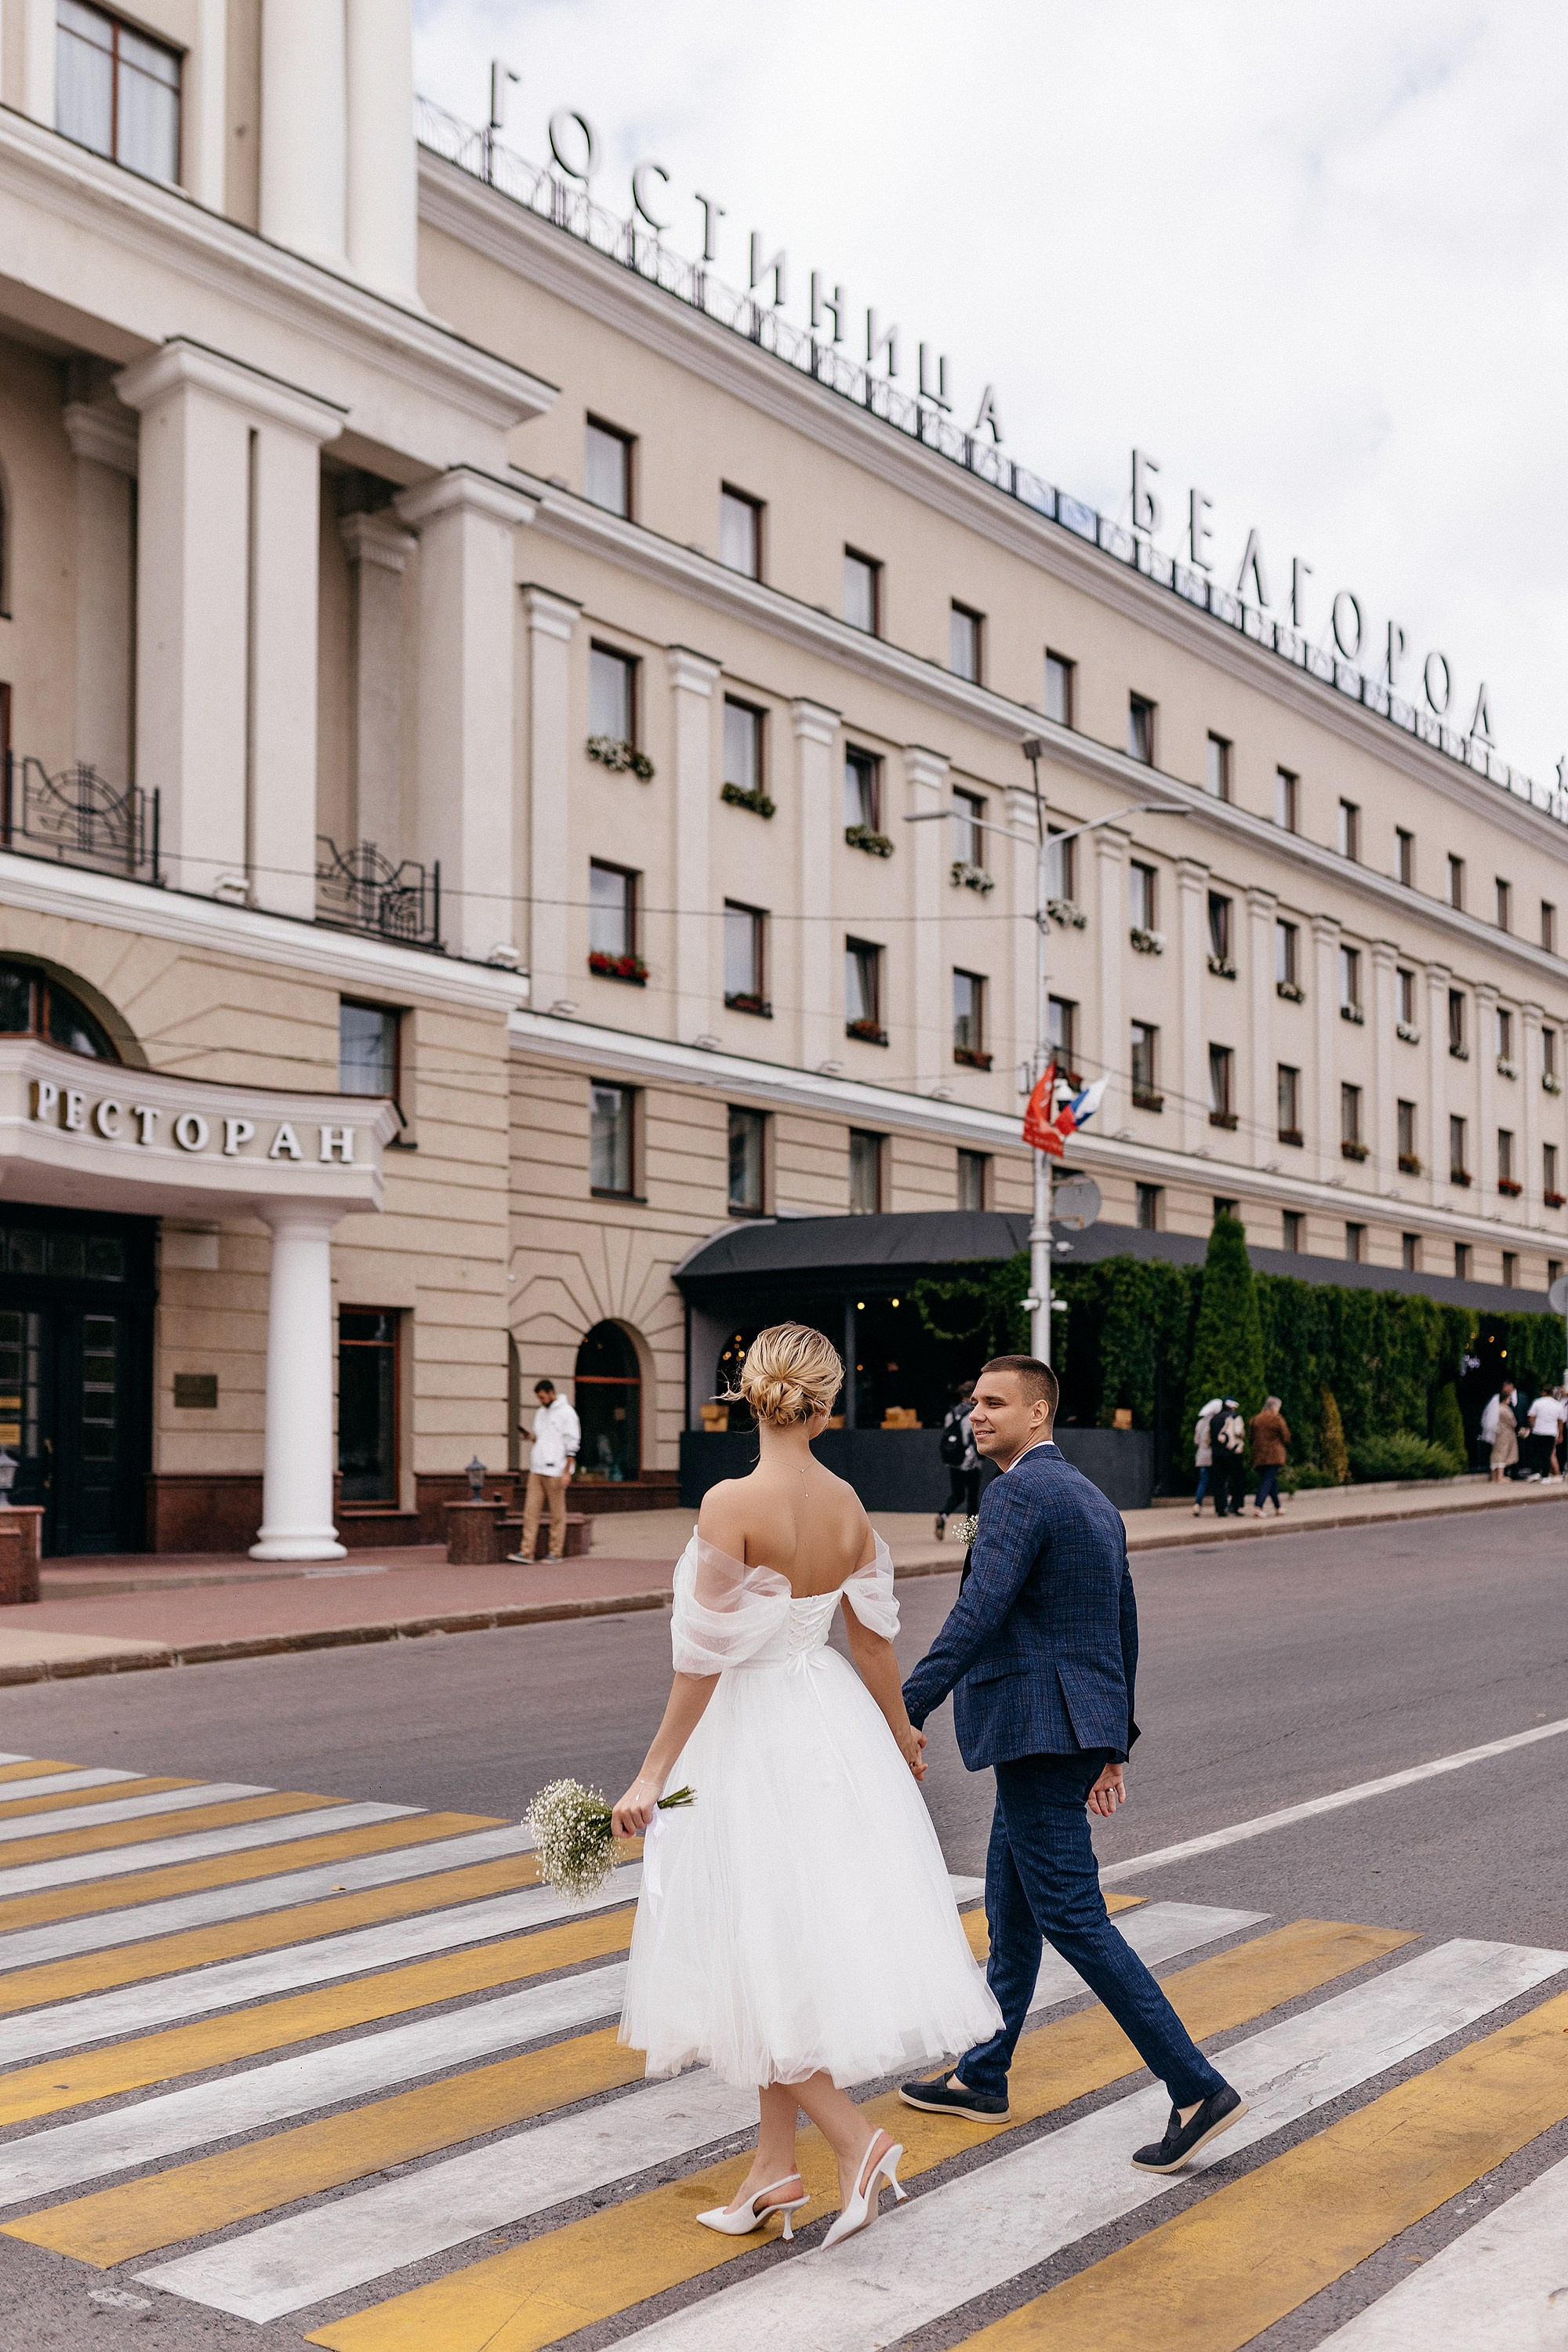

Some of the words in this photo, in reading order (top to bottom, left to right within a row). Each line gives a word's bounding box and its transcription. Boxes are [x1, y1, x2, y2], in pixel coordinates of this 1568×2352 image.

[489, 60, 1004, 442] ГОСТИНИЦА
[1132, 448, 1496, 750] БЕЛГОРОД
[36, 1080, 355, 1163] РЕСТОРАН
